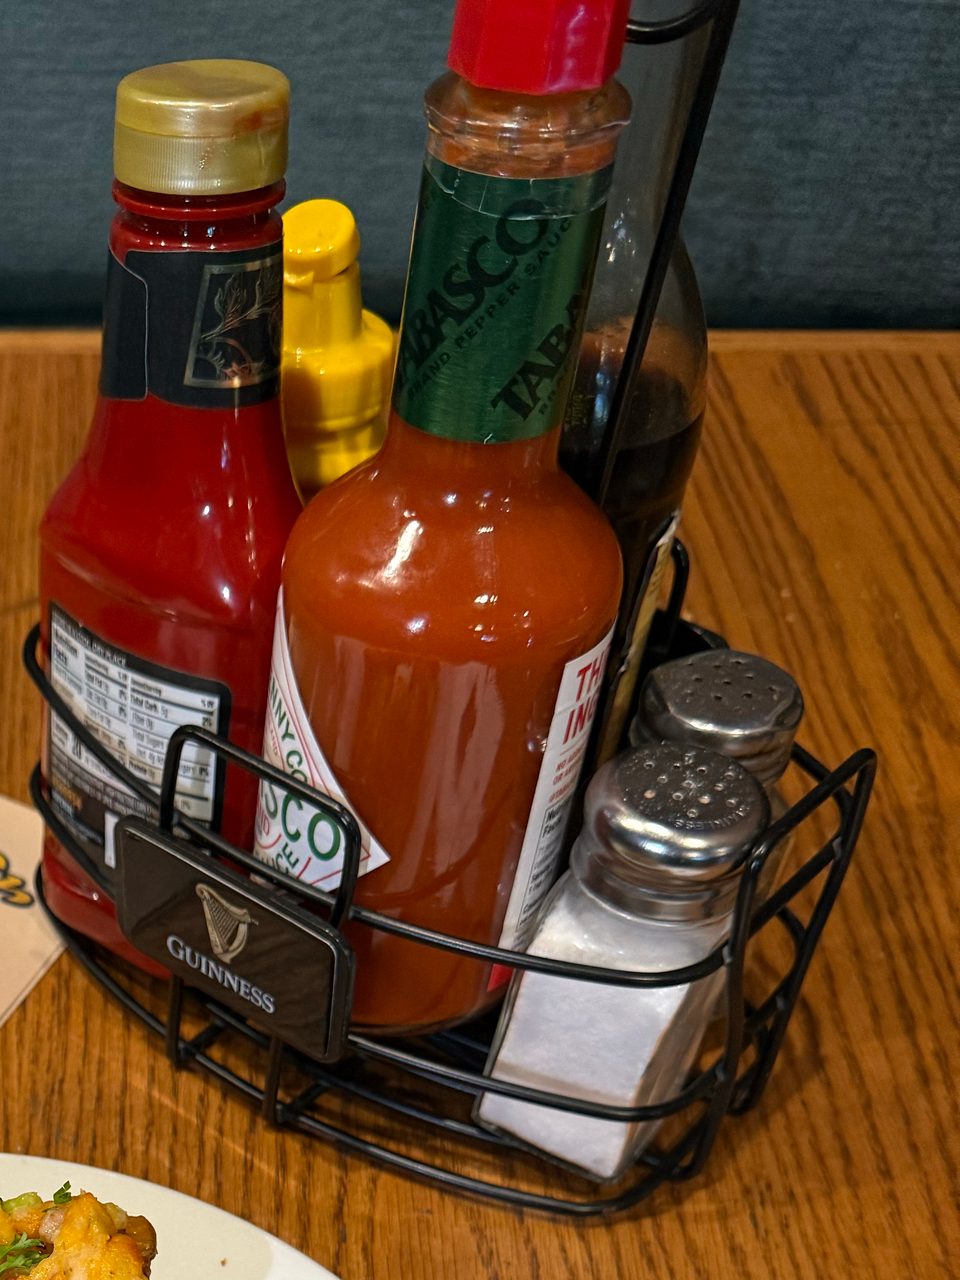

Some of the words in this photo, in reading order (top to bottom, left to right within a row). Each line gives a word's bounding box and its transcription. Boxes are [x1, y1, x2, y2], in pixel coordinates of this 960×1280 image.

[454, 282, 520, 349] PEPPER
[524, 216, 573, 280] SAUC
[166, 934, 276, 1014] GUINNESS
